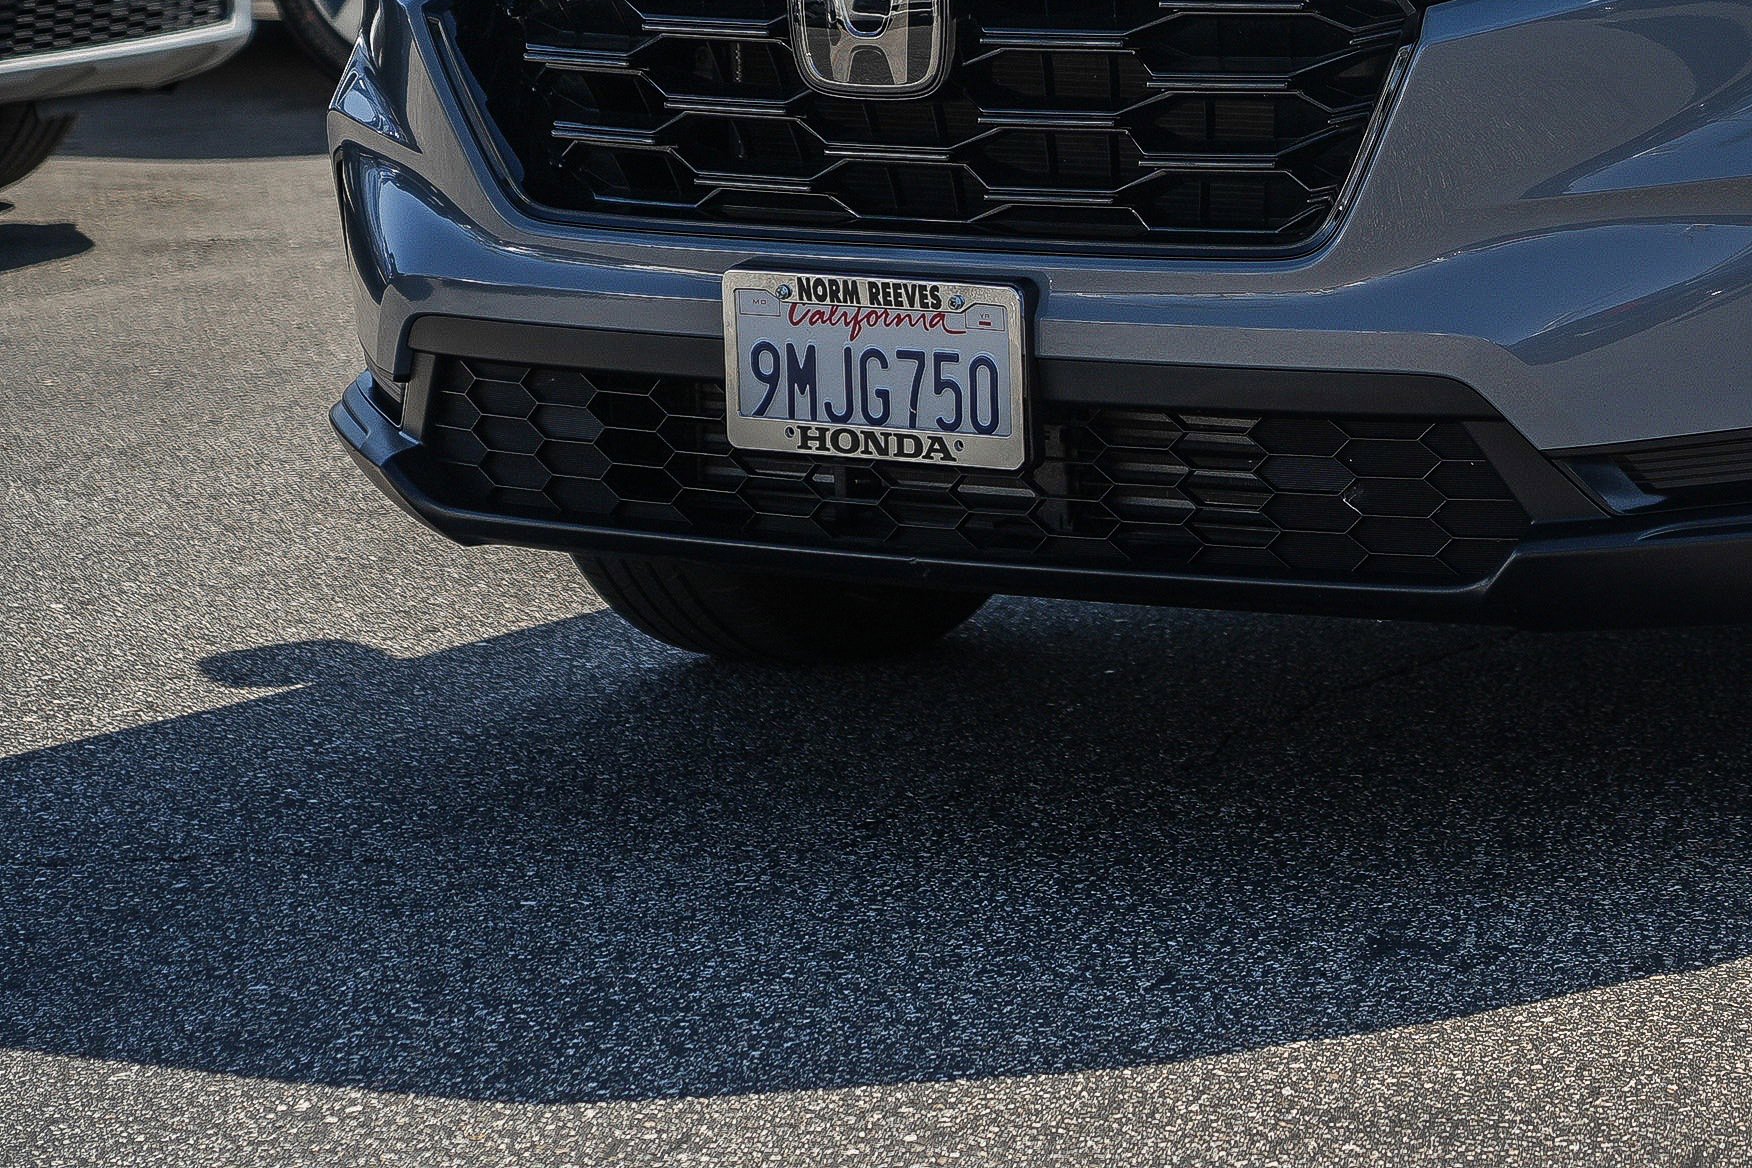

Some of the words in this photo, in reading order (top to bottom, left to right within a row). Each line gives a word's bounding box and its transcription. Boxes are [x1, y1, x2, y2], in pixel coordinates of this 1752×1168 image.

[796, 276, 860, 305] NORM
[867, 280, 942, 311] REEVES
[787, 302, 967, 341] California
[750, 340, 1000, 434] 9MJG750
[797, 424, 957, 462] HONDA
